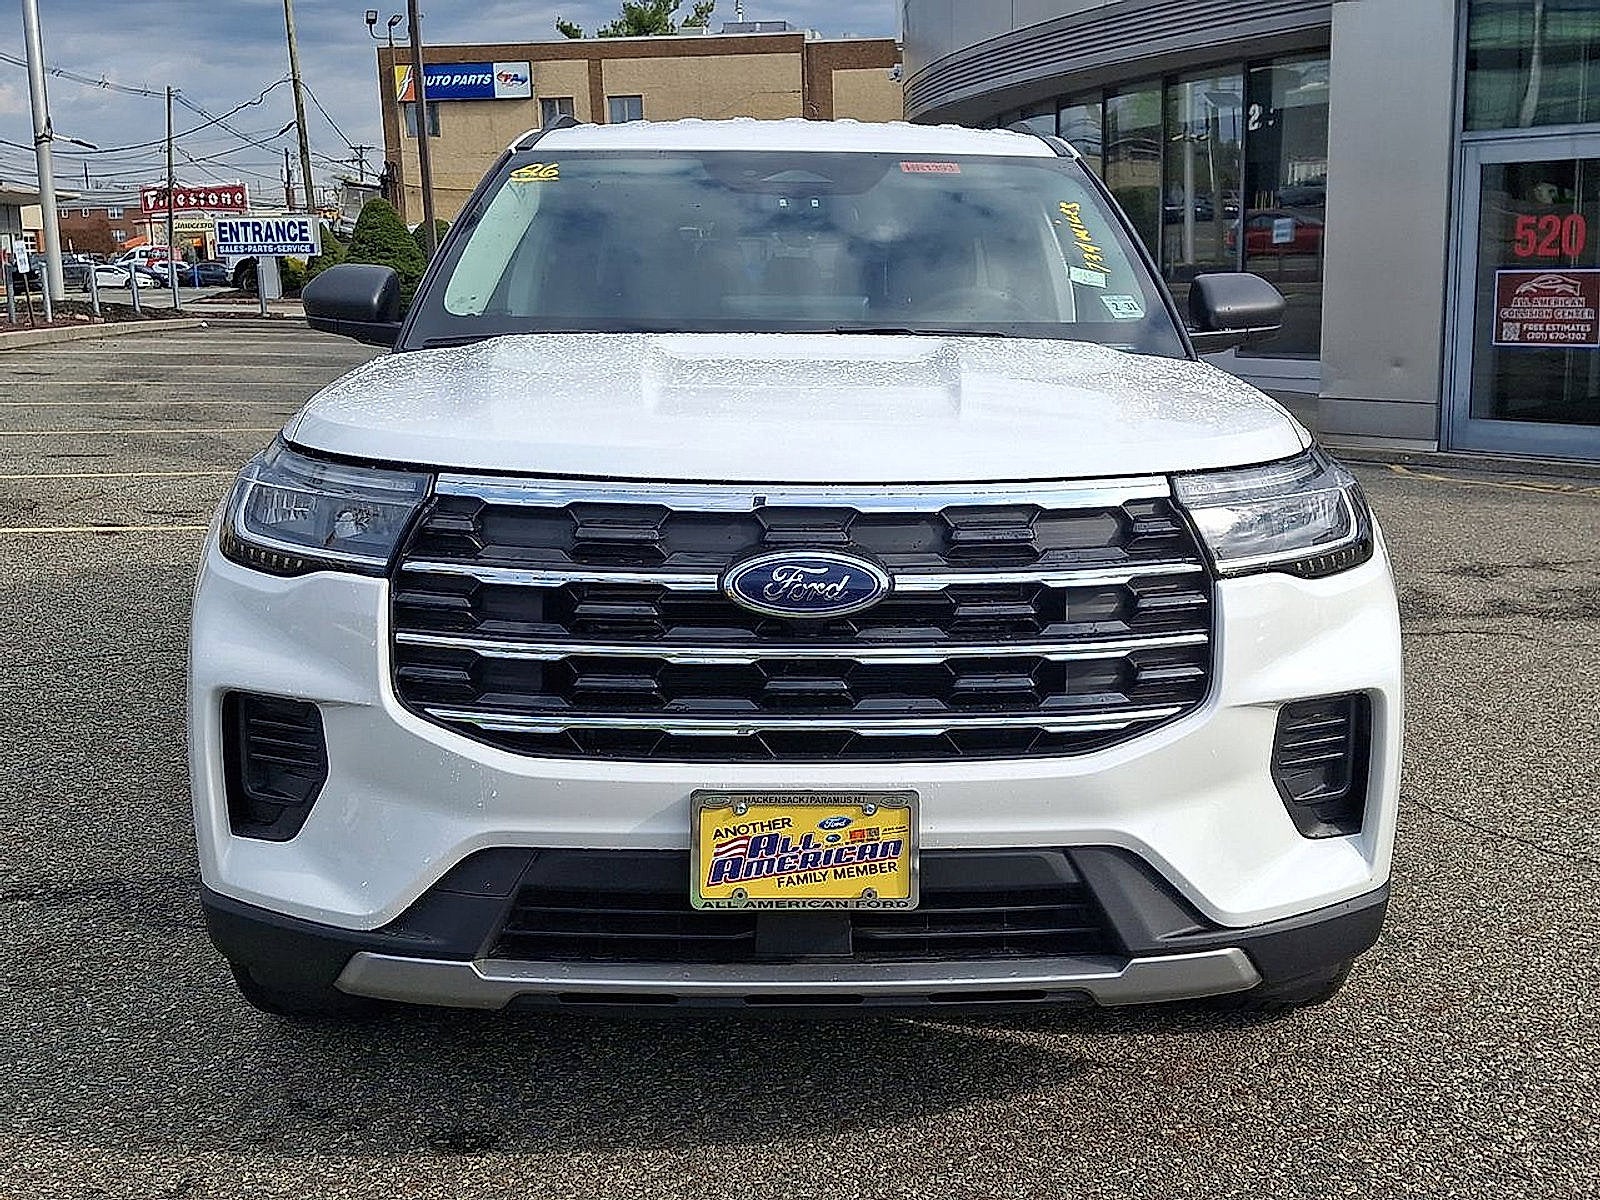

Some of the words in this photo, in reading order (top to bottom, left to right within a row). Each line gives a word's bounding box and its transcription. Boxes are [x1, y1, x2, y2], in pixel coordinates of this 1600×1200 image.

[423, 75, 451, 87] UTO
[451, 74, 492, 86] PARTS
[218, 220, 310, 242] ENTRANCE
[1514, 213, 1587, 257] 520
[1545, 323, 1592, 332] ESTIMATES
[763, 565, 851, 601] Ford
[713, 817, 793, 841] ANOTHER
[747, 832, 822, 859] ALL
[709, 839, 903, 883] AMERICAN
[776, 869, 829, 889] FAMILY
[833, 861, 898, 880] MEMBER
[701, 901, 739, 909] ALL
[742, 901, 848, 909] AMERICAN
[855, 901, 909, 909] FORD
